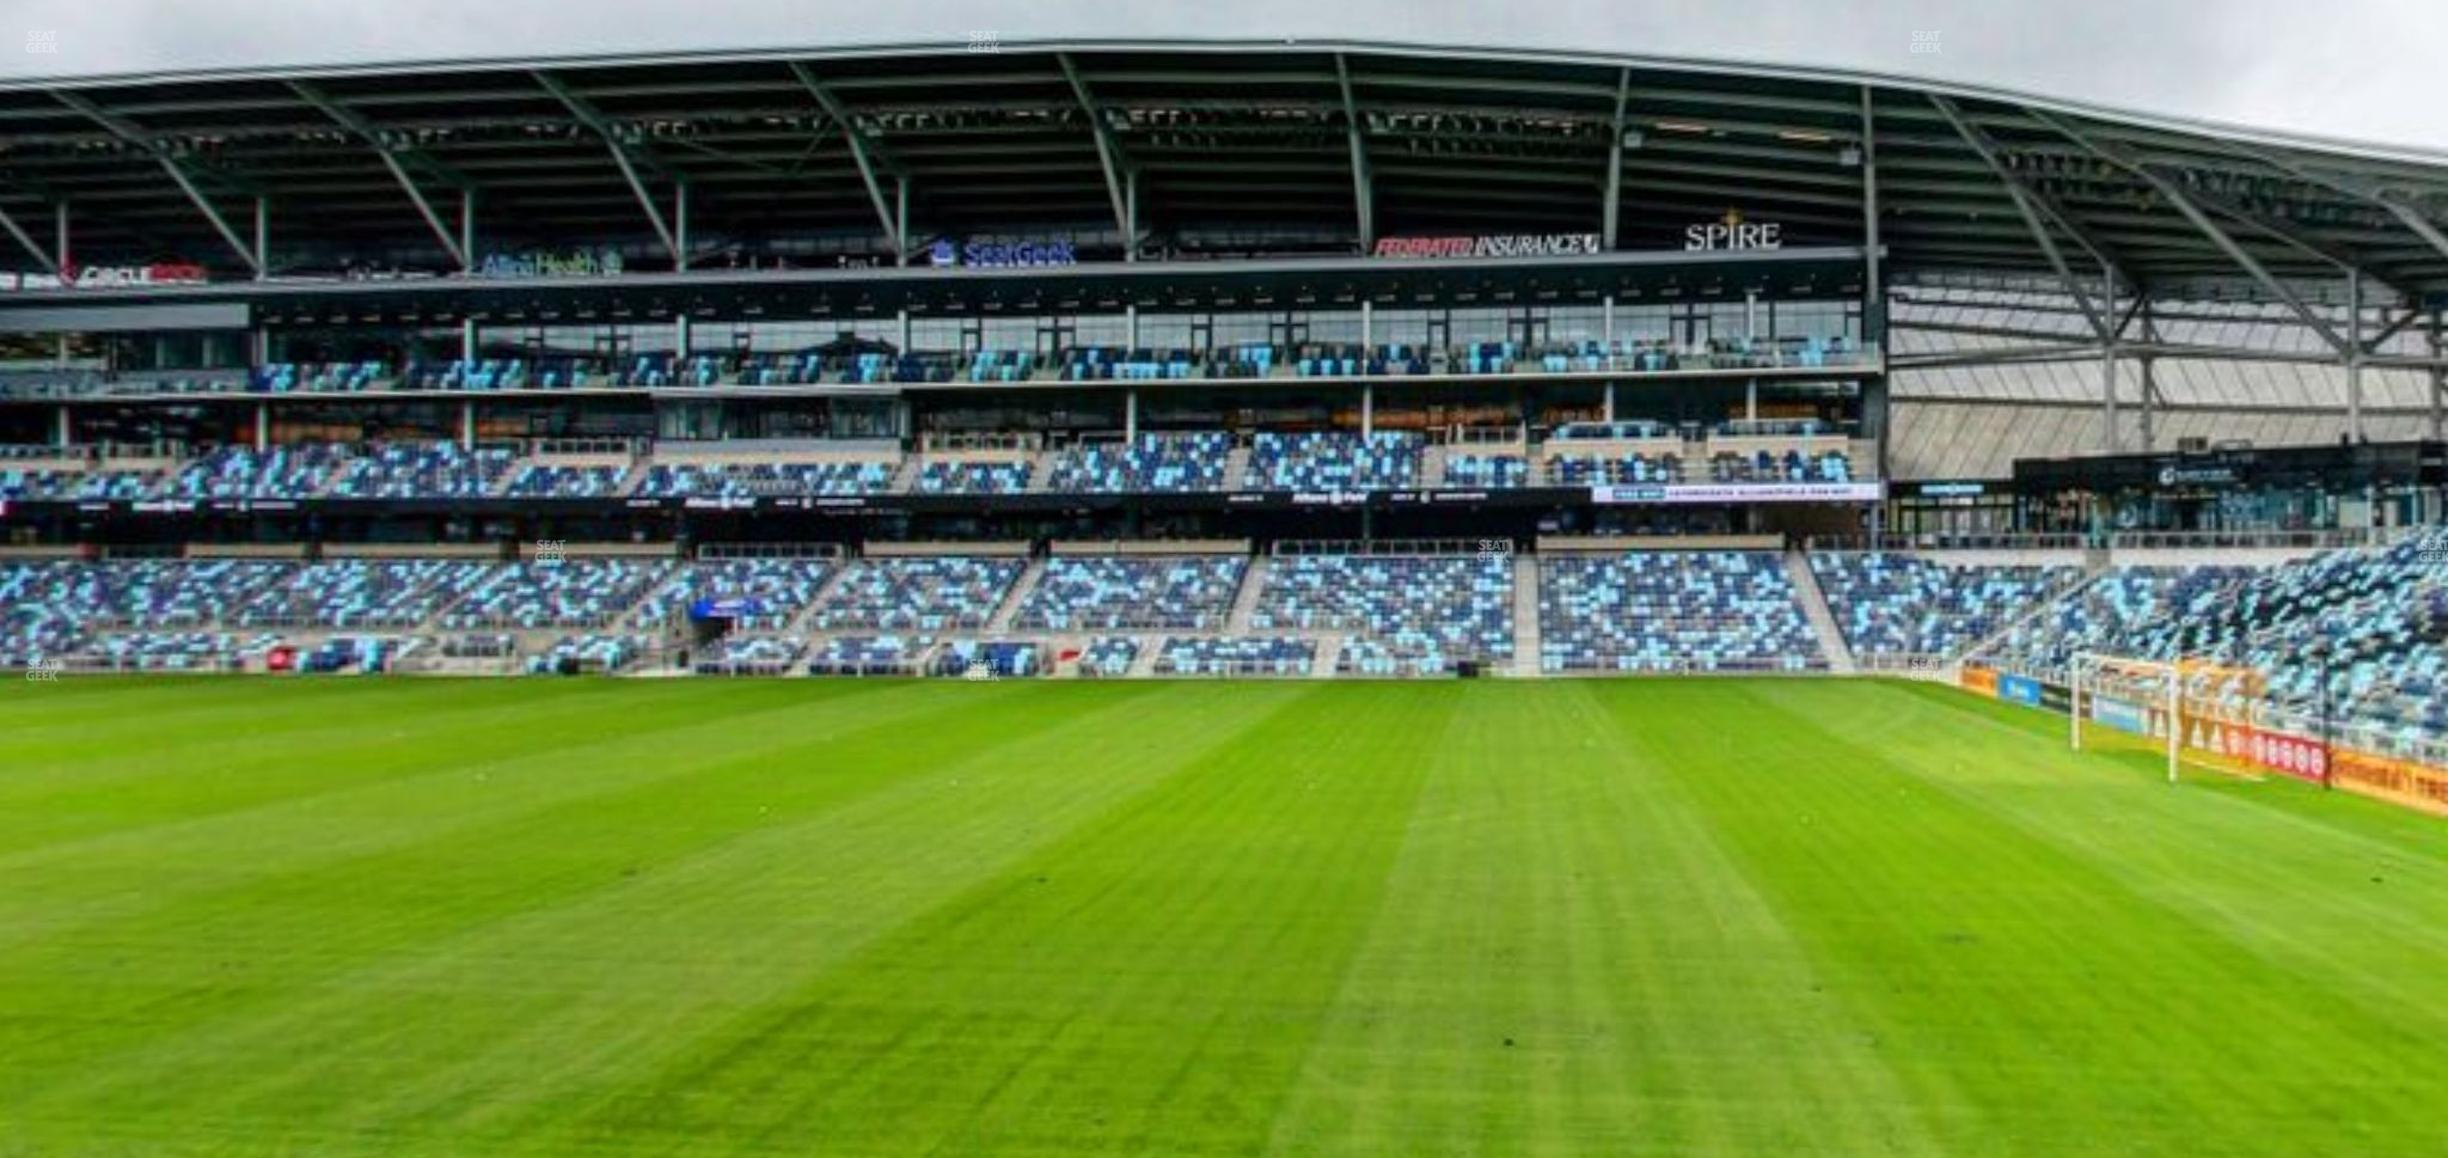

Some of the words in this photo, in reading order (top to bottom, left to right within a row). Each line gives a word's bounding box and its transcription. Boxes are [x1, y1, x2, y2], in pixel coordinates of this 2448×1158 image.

[1375, 238, 1473, 258] FEDERATED
[1475, 234, 1582, 257] INSURANCE
[1685, 222, 1782, 250] SPIRE
[964, 240, 1076, 267] SeatGeek
